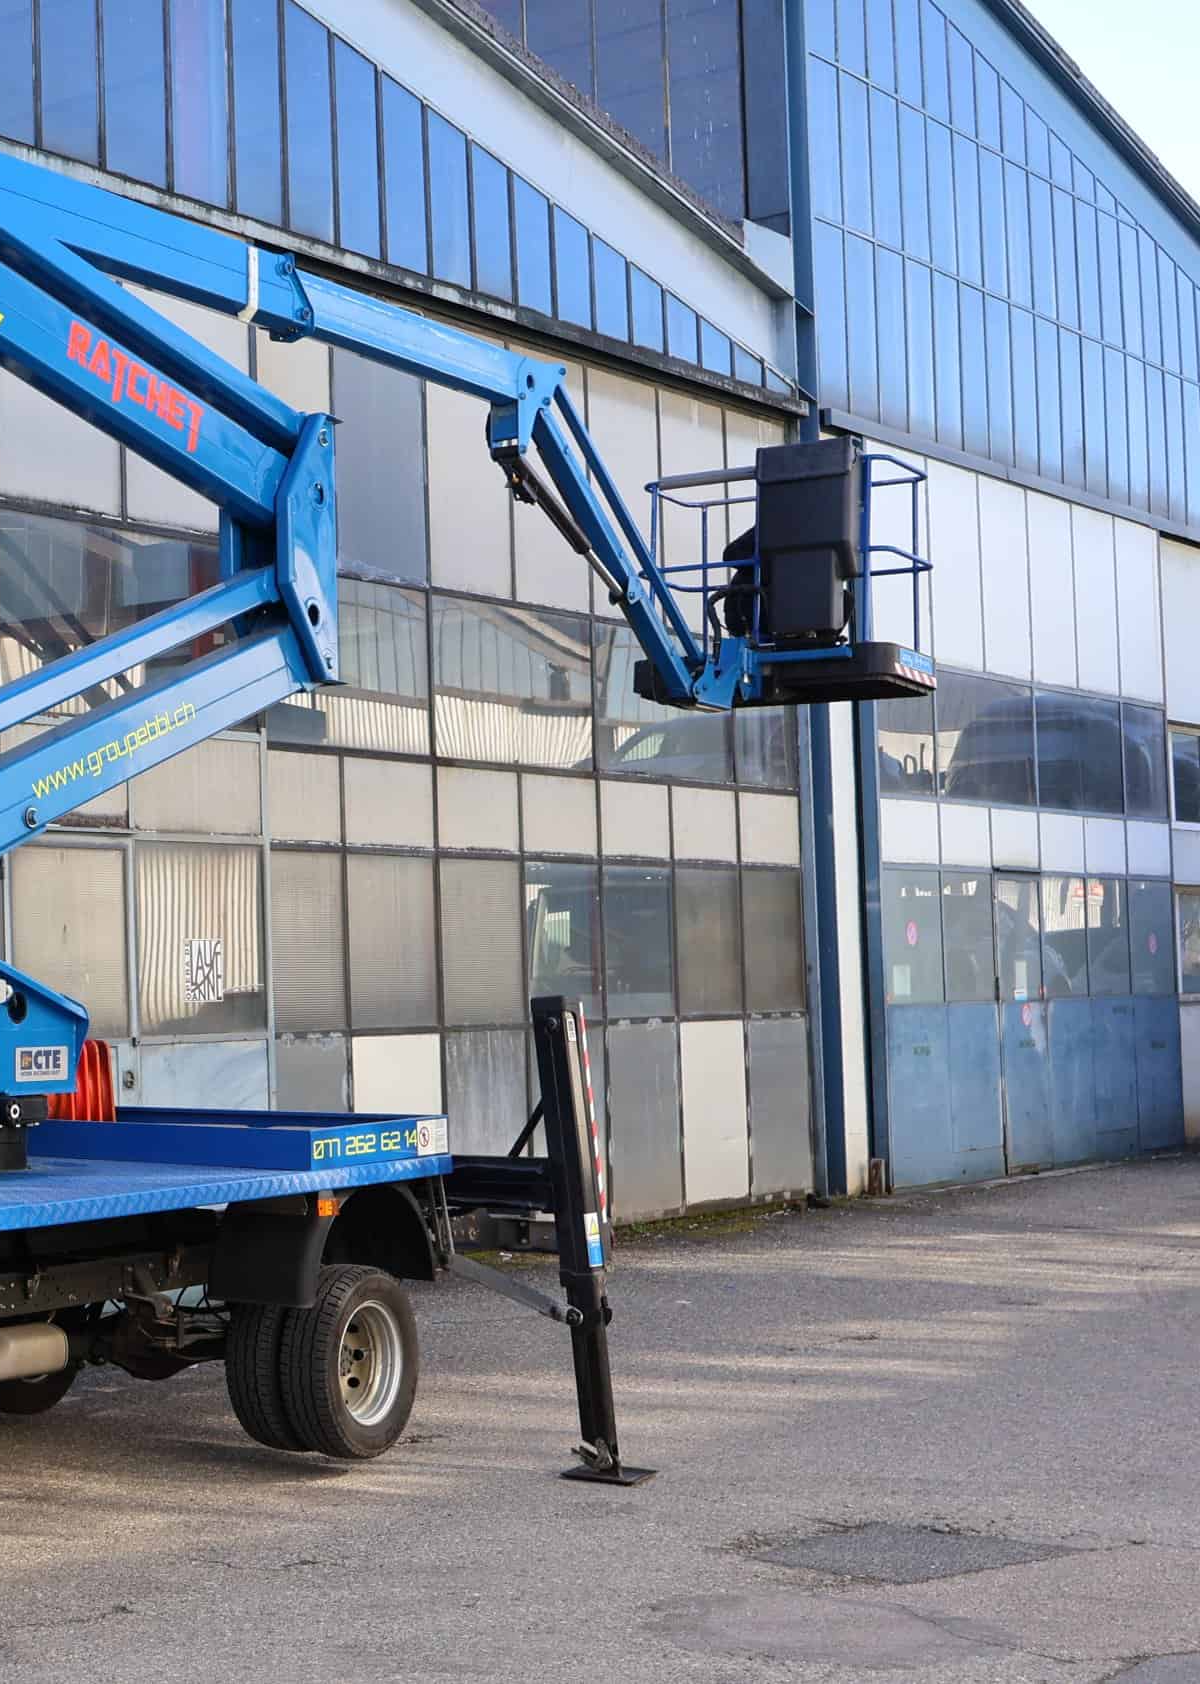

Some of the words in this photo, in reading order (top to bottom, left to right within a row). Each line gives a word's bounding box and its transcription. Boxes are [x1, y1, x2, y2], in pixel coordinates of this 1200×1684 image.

[67, 319, 204, 452] RATCHET
[31, 701, 196, 799] www.groupebbl.ch
[34, 1049, 61, 1070] CTE
